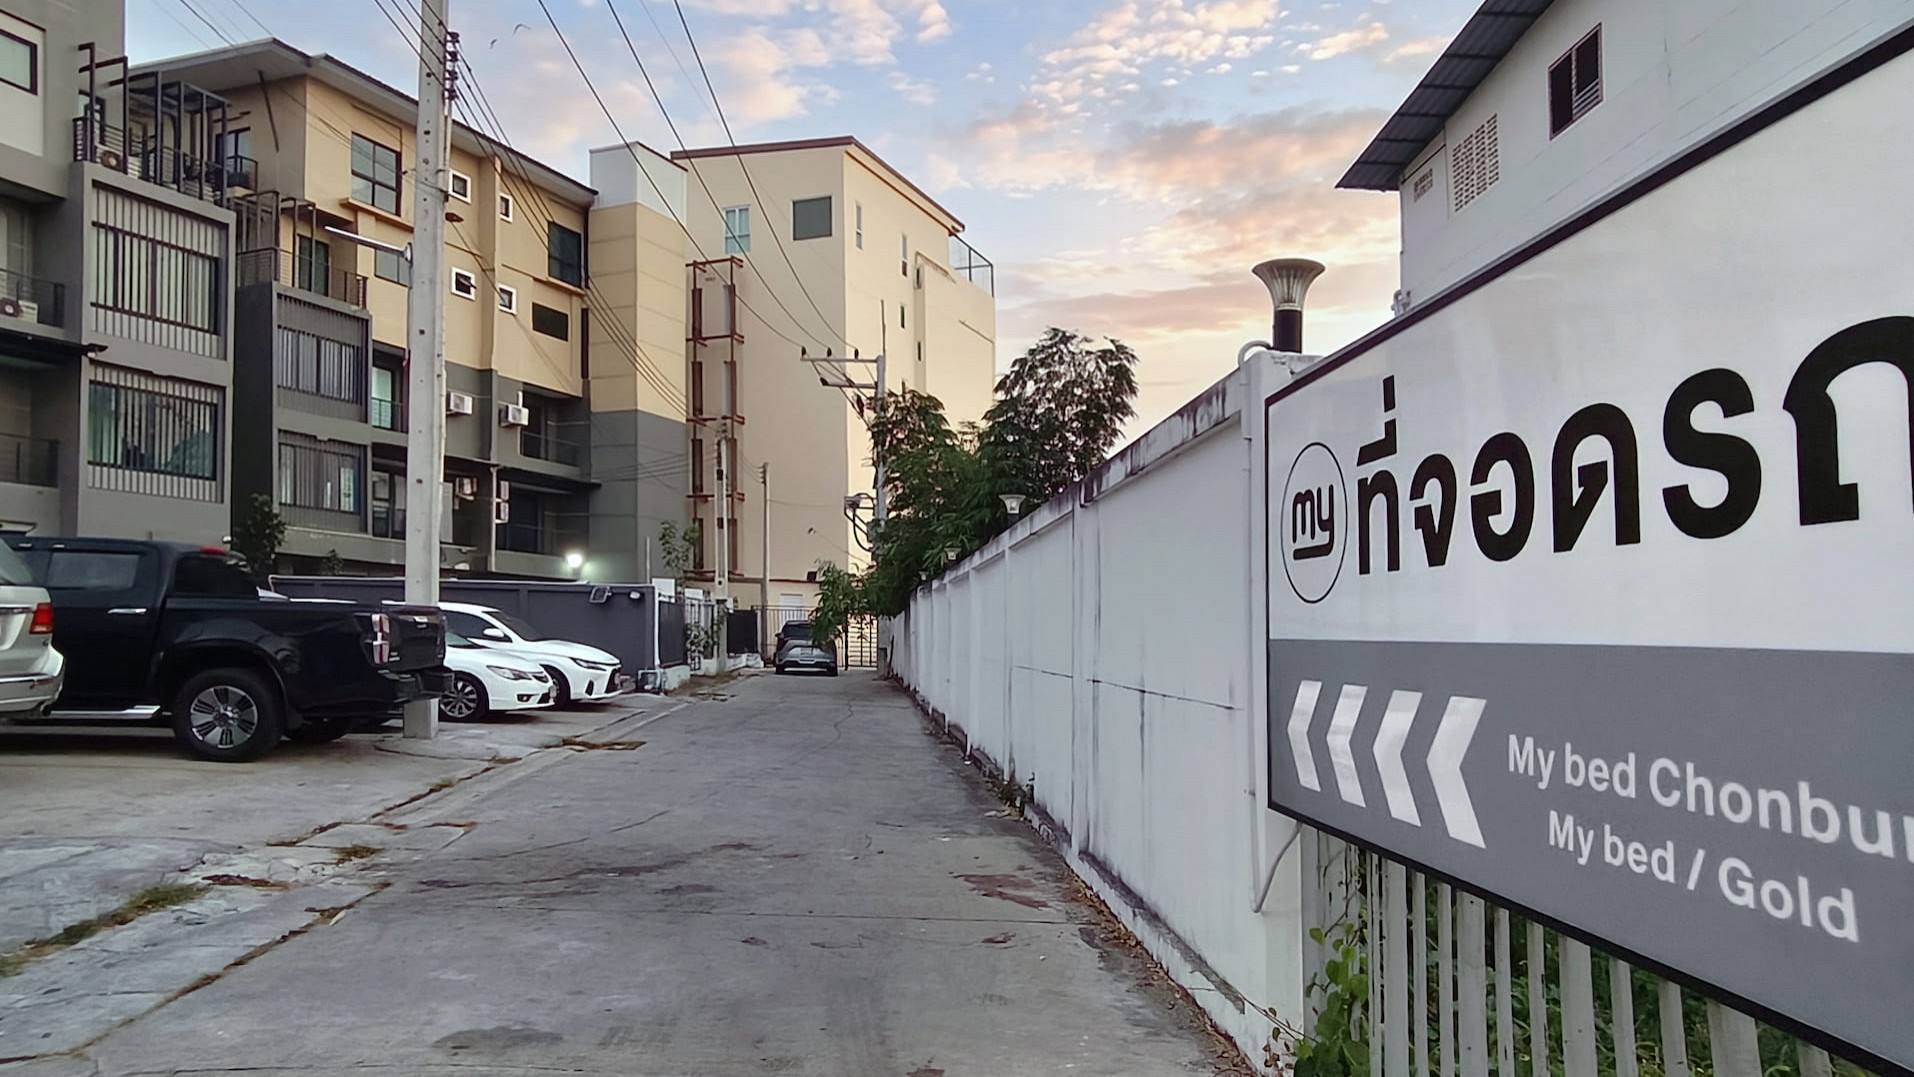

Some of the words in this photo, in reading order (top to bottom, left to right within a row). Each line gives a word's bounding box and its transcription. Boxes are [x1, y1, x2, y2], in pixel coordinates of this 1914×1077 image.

[1292, 484, 1335, 561] my
[1508, 733, 1556, 790] My
[1564, 741, 1637, 800] bed
[1549, 809, 1595, 867] My
[1603, 822, 1676, 885] bed
[1686, 848, 1706, 892] /
[1717, 856, 1860, 943] Gold
